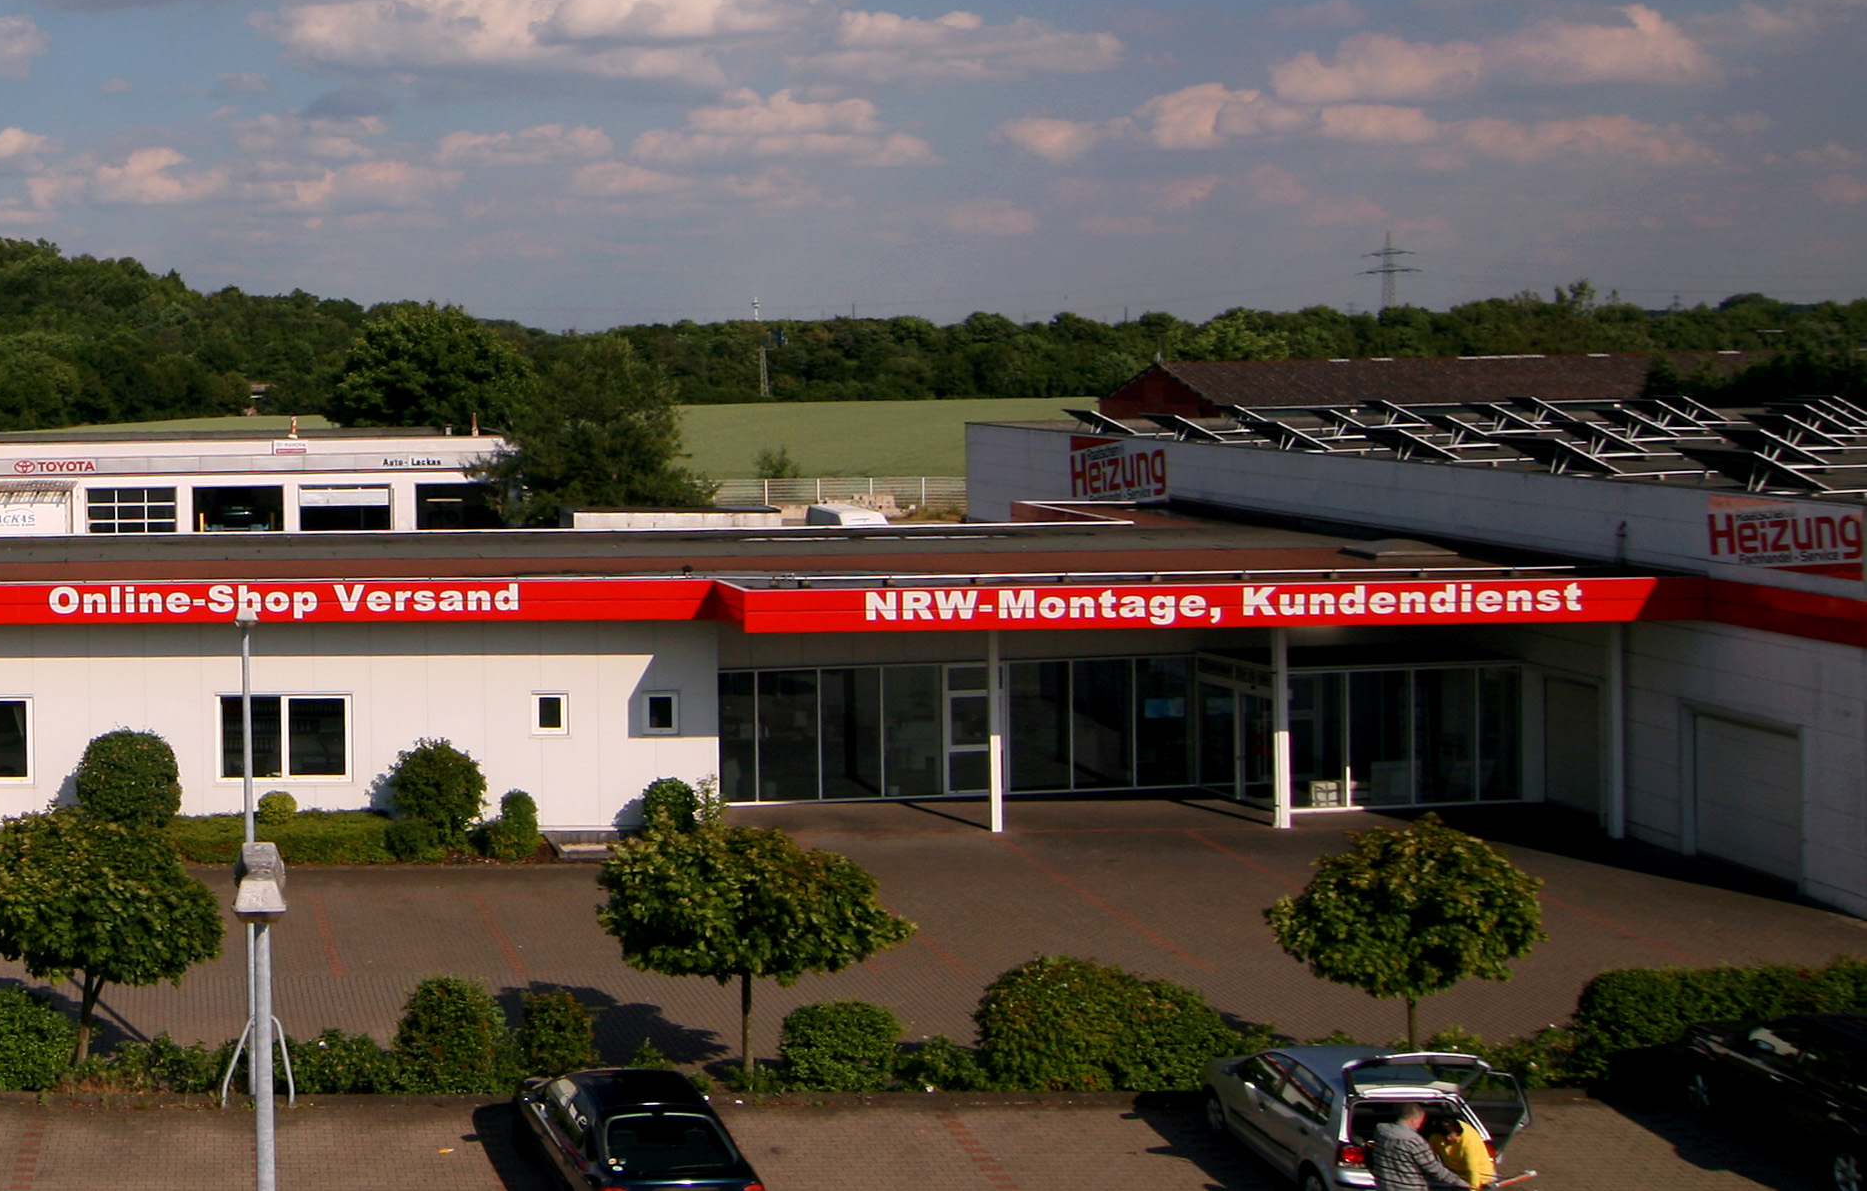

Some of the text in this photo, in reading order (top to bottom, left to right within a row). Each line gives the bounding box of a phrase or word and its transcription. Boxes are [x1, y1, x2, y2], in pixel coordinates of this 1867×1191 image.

[38, 461, 96, 472] TOYOTA
[411, 457, 441, 466] Lackas
[1069, 448, 1167, 499] Heizung
[1707, 512, 1864, 560] Heizung
[1800, 550, 1840, 563] Service
[48, 582, 520, 620] Online-Shop Versand
[865, 582, 1583, 626] NRW-Montage, Kundendienst
